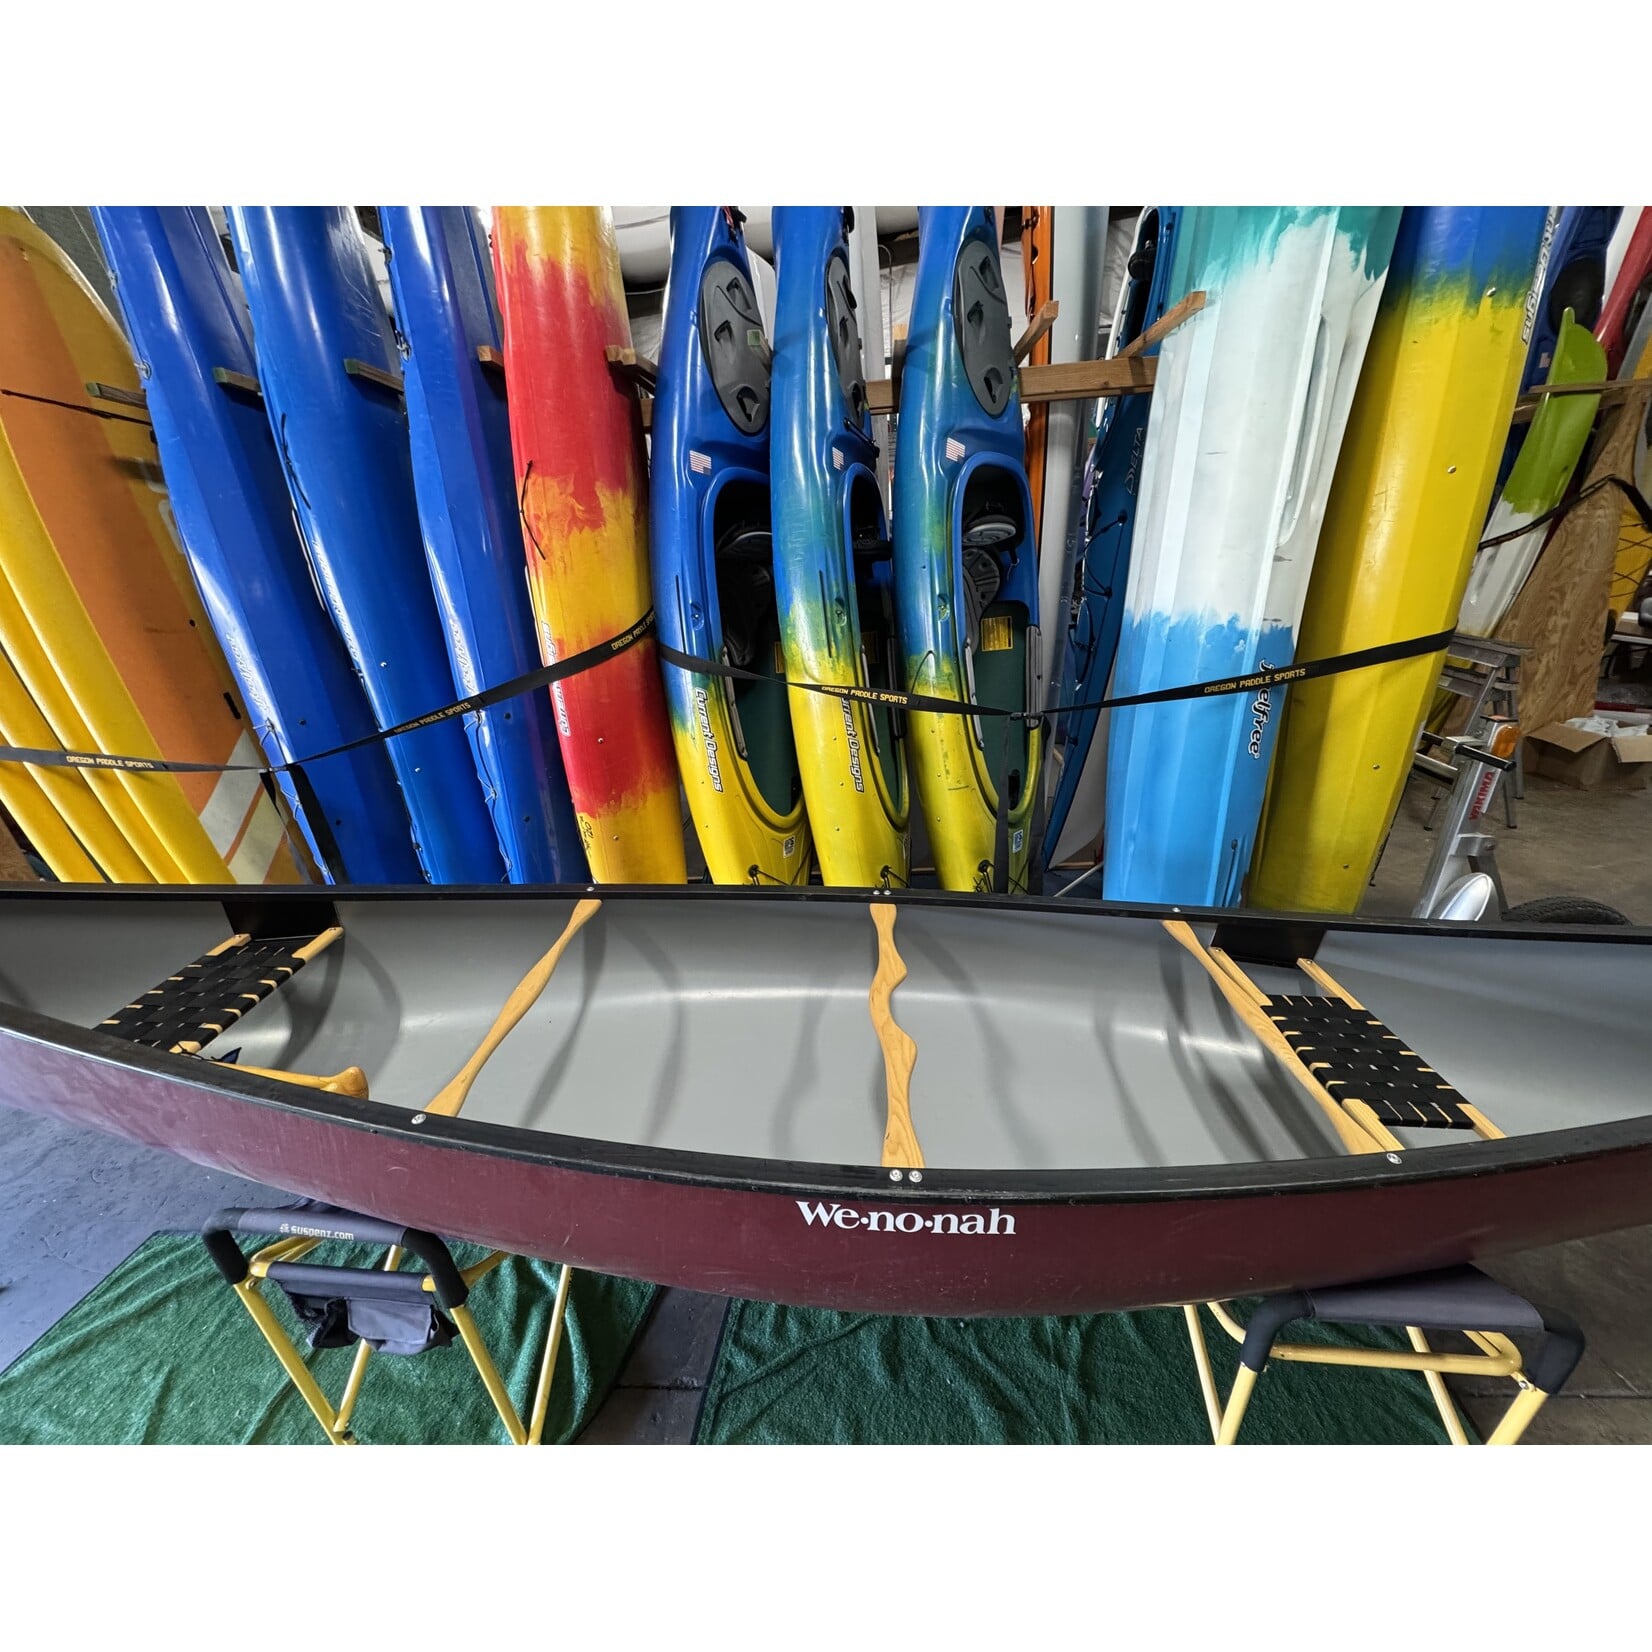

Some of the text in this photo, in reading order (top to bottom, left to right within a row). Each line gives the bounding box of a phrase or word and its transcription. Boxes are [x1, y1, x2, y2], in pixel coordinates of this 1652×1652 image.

[611, 634, 634, 650] OREGON
[1204, 668, 1306, 694] OREGON PADDLE SPORTS
[820, 686, 908, 705] OREGON PADDLE SPORTS
[444, 701, 472, 717] SPORTS
[1248, 659, 1275, 757] felfree
[695, 687, 723, 793] Current Designs
[841, 697, 865, 793] urrent Designs
[95, 757, 124, 767] PADDLE
[124, 760, 154, 769] SPORTS
[1468, 771, 1495, 820] YAKIMA
[290, 1224, 354, 1240] suspenz.com
